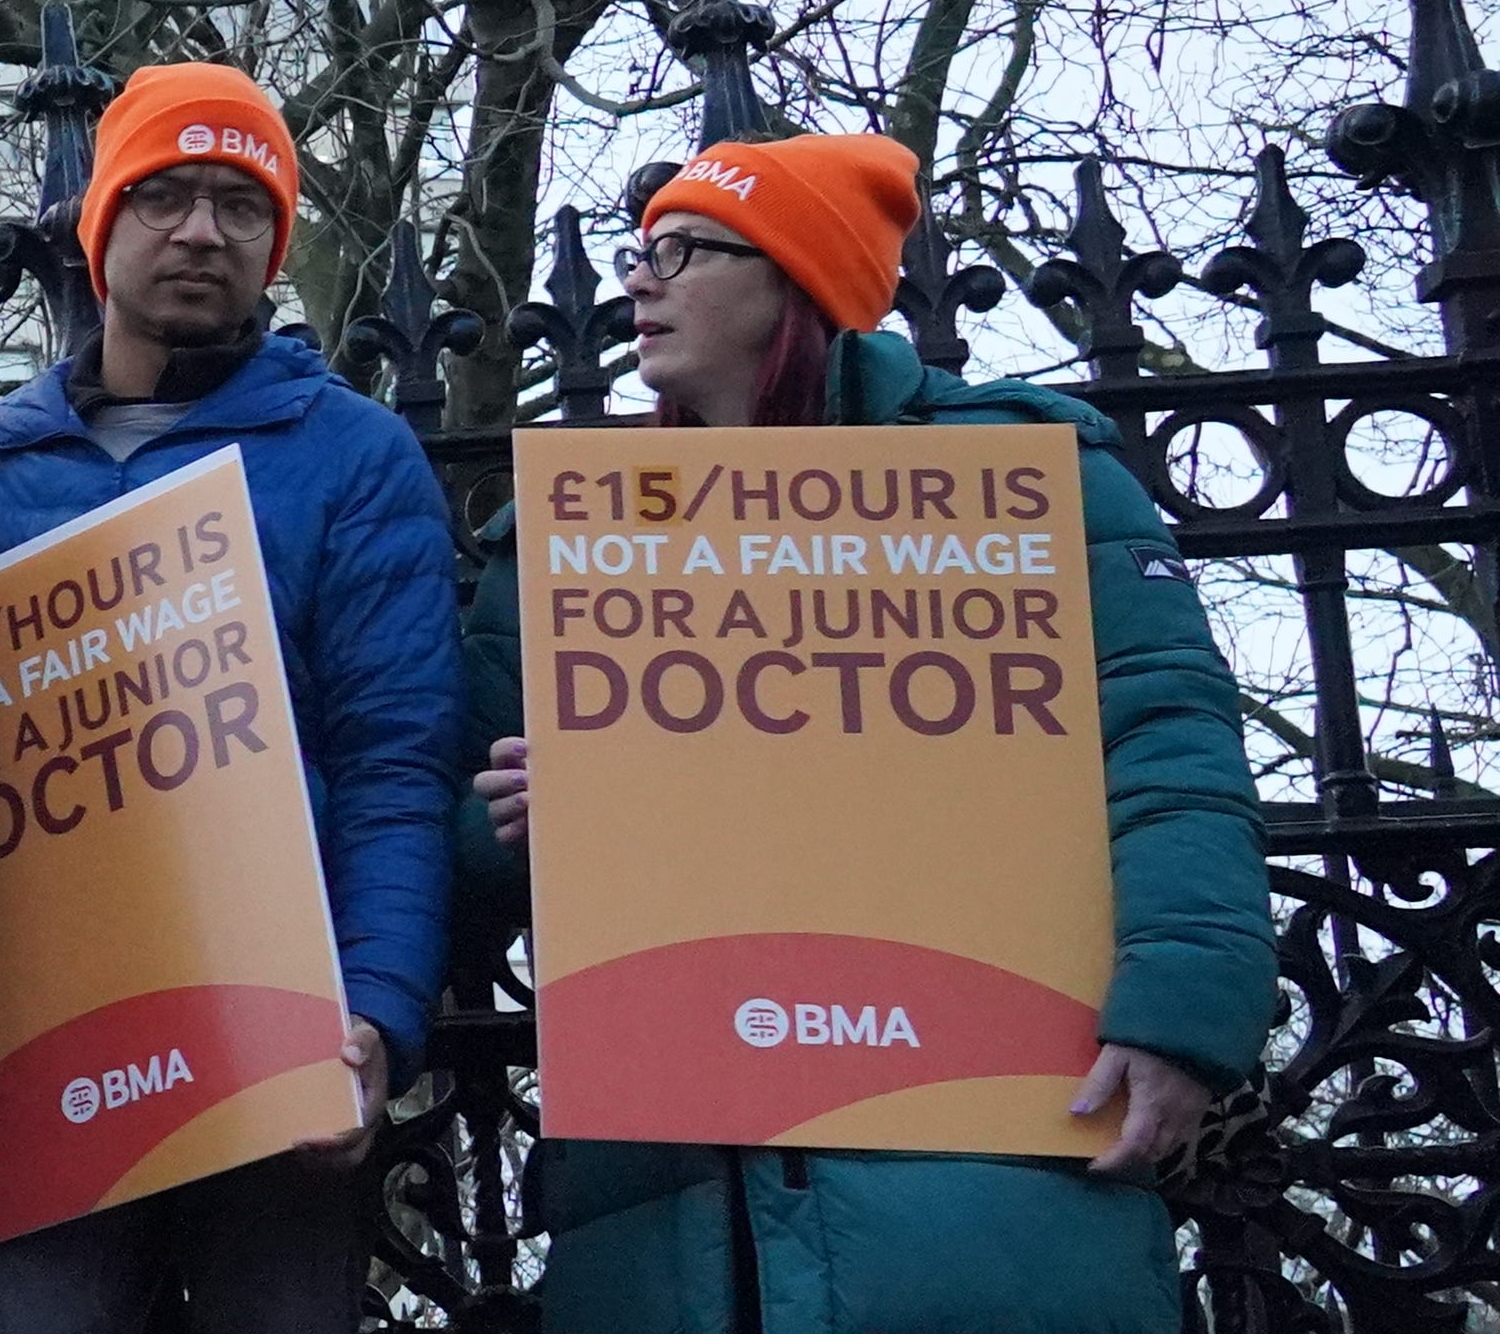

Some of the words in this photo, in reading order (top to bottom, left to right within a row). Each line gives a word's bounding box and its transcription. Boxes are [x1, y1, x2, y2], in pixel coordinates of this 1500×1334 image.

[221, 128, 278, 176] BMA
[683, 161, 756, 201] BMA
[549, 465, 957, 522] £15/HOUR
[982, 468, 1049, 520] IS
[177, 512, 229, 573] IS
[548, 533, 669, 576] NOT
[682, 534, 726, 575] A
[738, 533, 871, 576] FAIR
[878, 531, 1058, 577] WAGE
[18, 628, 112, 698] FAIR
[115, 569, 241, 652] WAGE
[553, 588, 696, 638] FOR
[716, 590, 767, 638] A
[783, 589, 1061, 648] JUNIOR
[14, 712, 48, 762] A
[58, 622, 253, 751] JUNIOR
[555, 650, 1068, 736] DOCTOR
[795, 1004, 920, 1048] BMA
[102, 1049, 194, 1109] BMA
